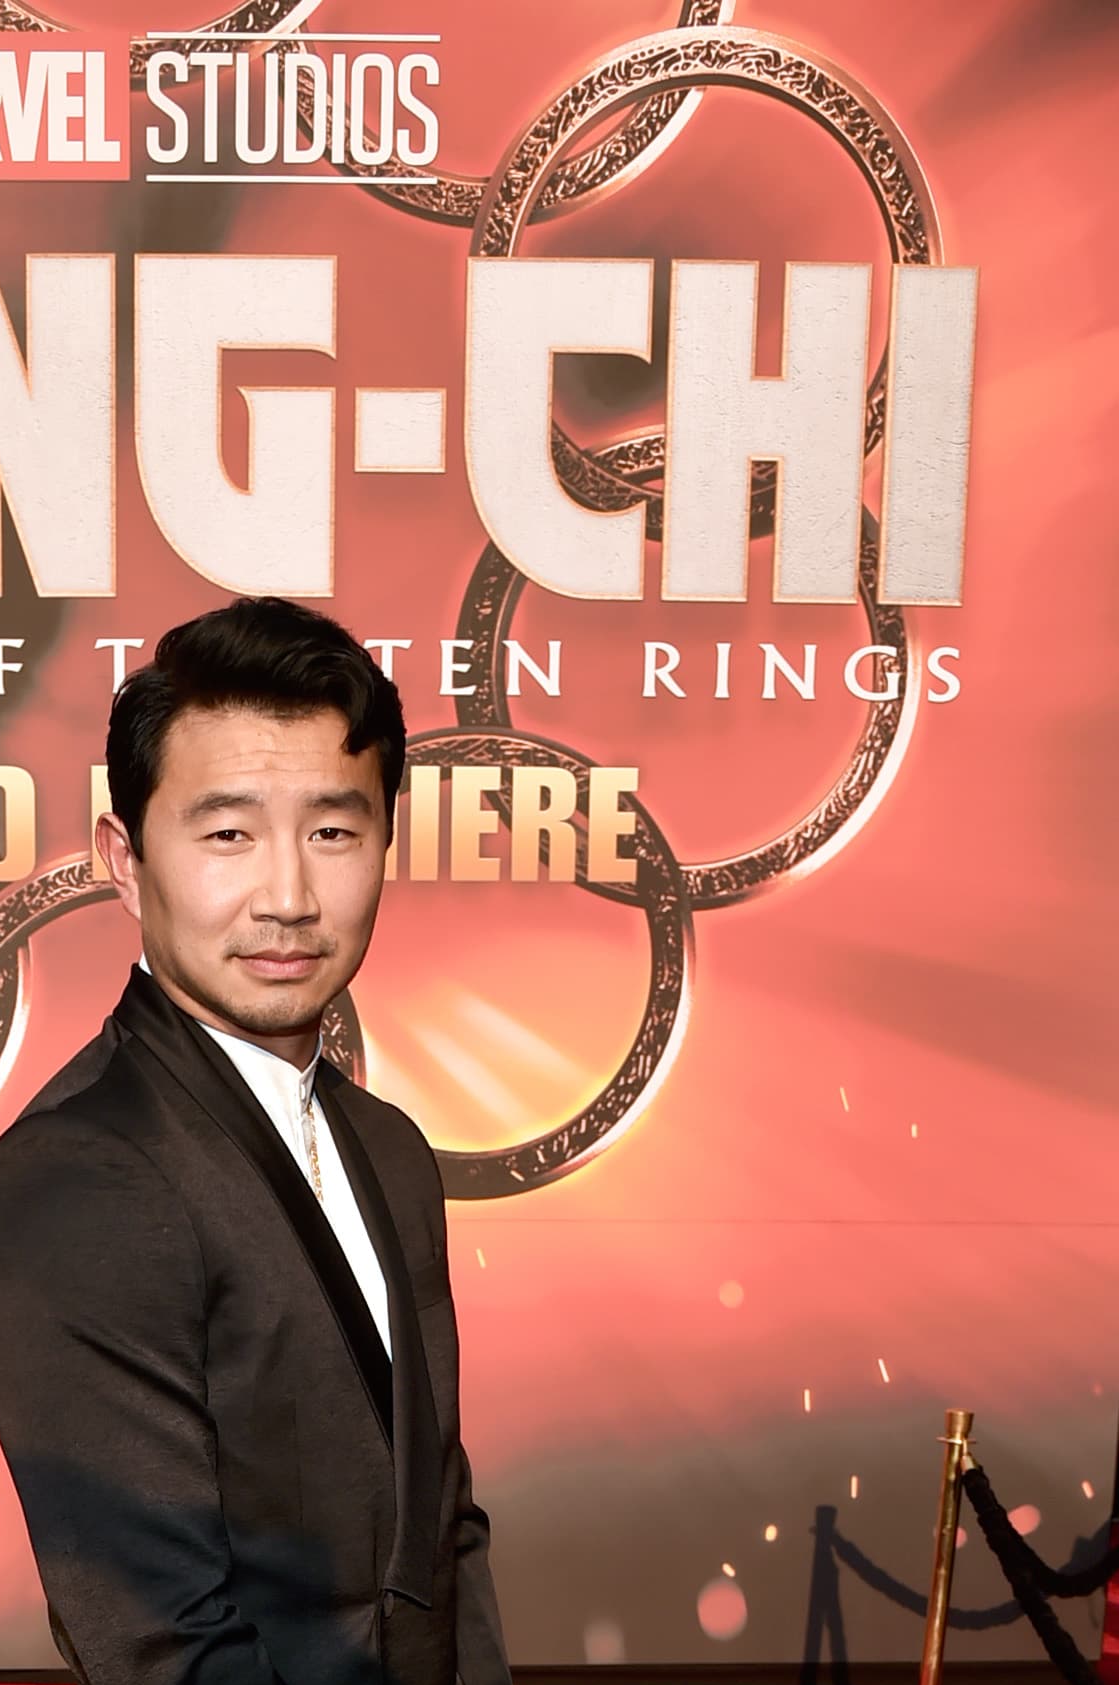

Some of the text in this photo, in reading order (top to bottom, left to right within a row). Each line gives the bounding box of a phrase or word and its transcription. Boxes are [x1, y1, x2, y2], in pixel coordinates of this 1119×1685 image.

[146, 53, 439, 167] STUDIOS
[363, 638, 562, 697] TEN
[642, 641, 961, 703] RINGS
